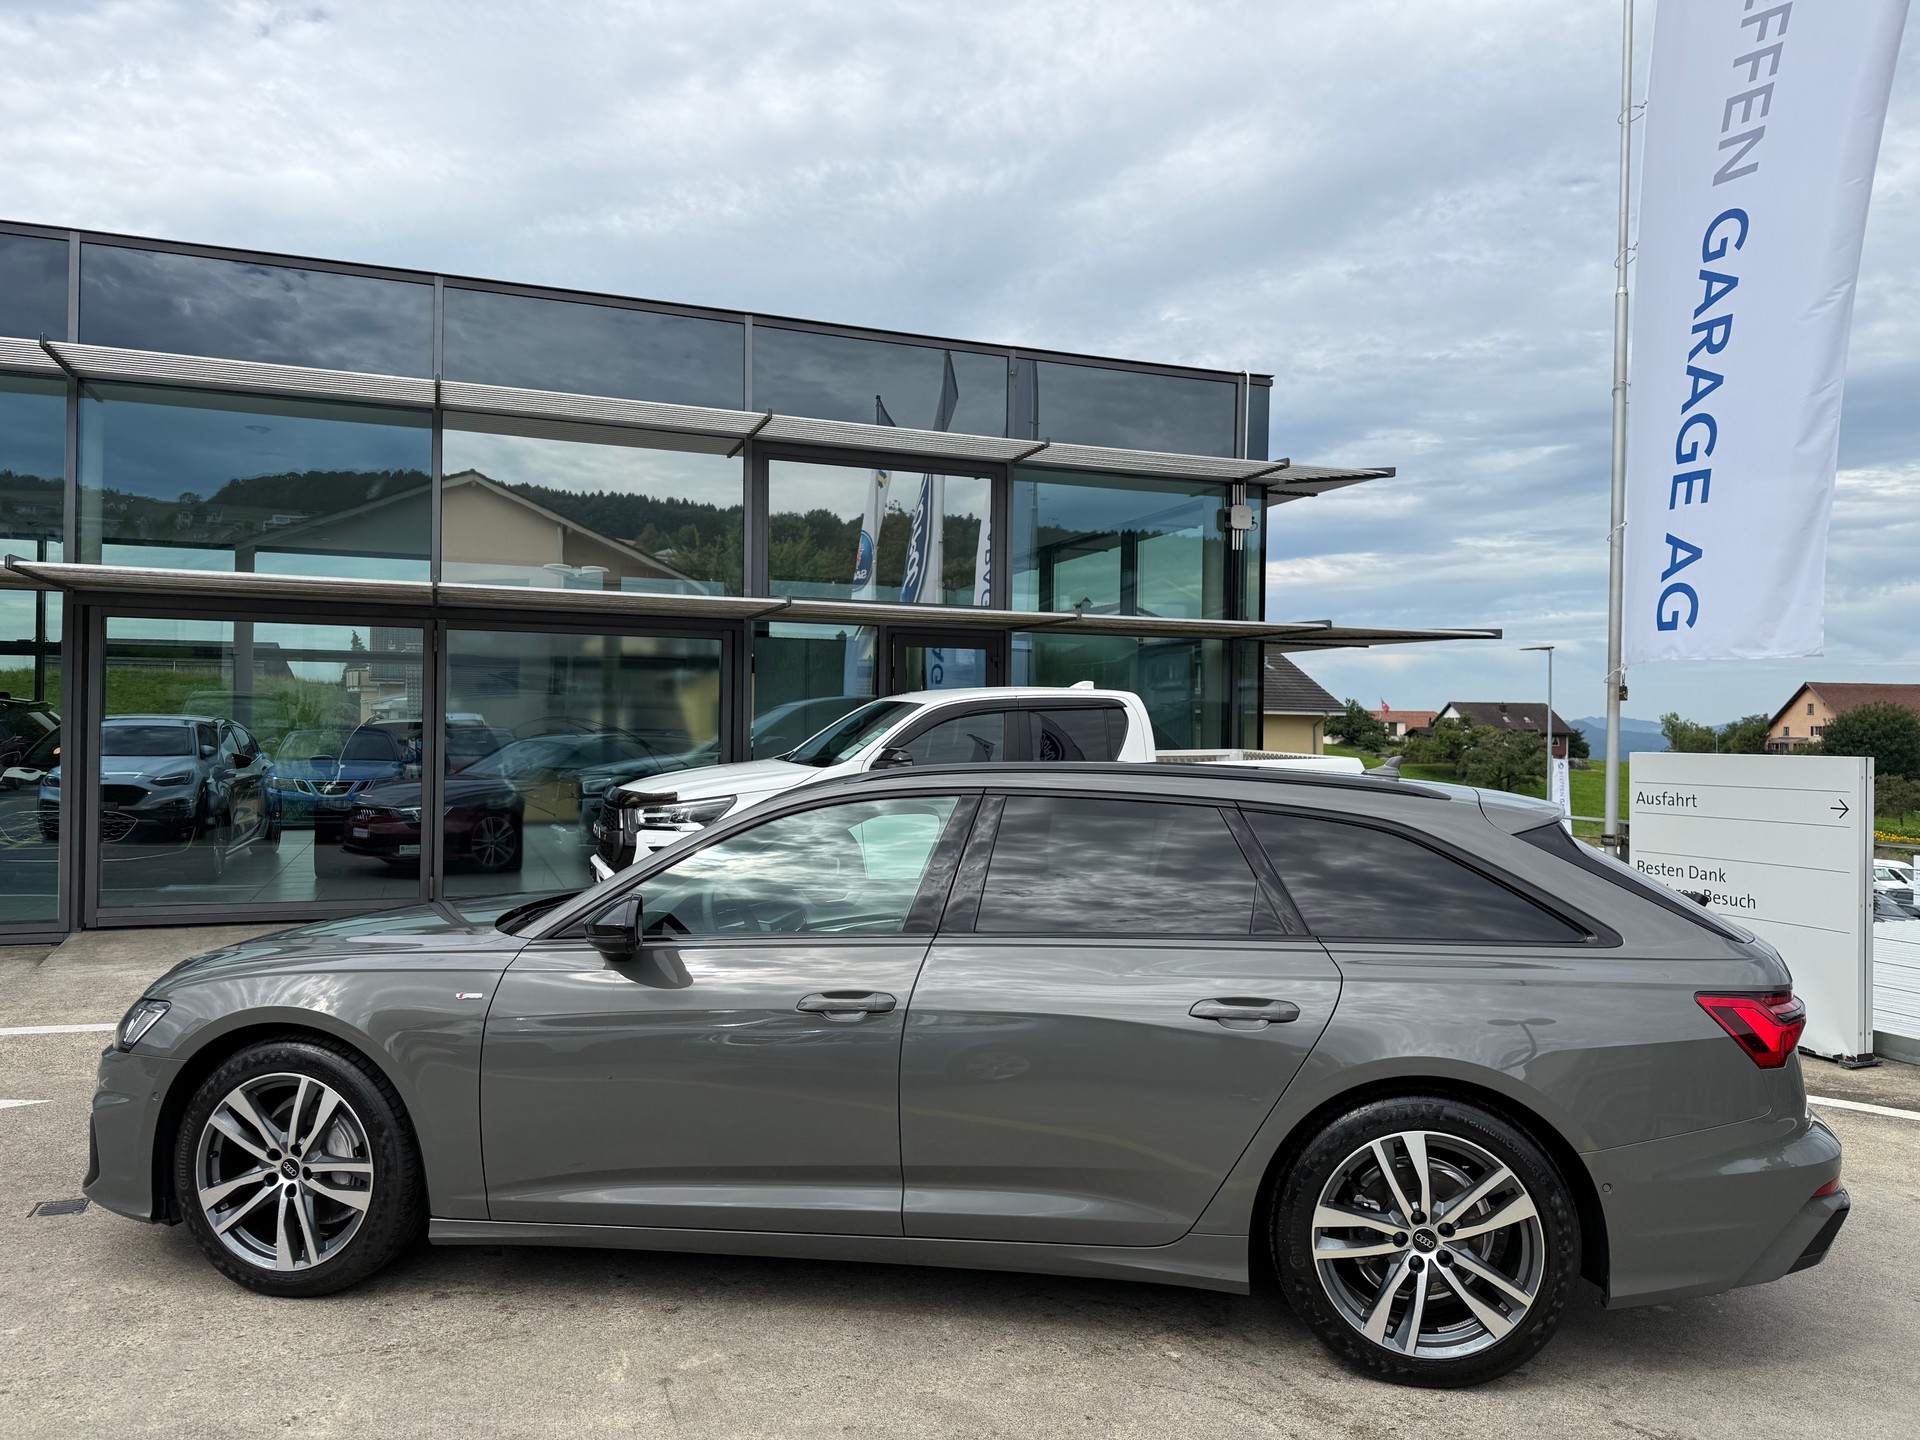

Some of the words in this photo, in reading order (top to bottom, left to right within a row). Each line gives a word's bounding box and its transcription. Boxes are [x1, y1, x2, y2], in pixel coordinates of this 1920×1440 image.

[1711, 0, 1793, 187] FFEN
[1669, 208, 1749, 510] GARAGE
[1656, 532, 1703, 631] AG
[1636, 791, 1698, 808] Ausfahrt
[1636, 860, 1684, 878] Besten
[1689, 865, 1726, 883] Dank
[1703, 889, 1756, 909] Besuch
